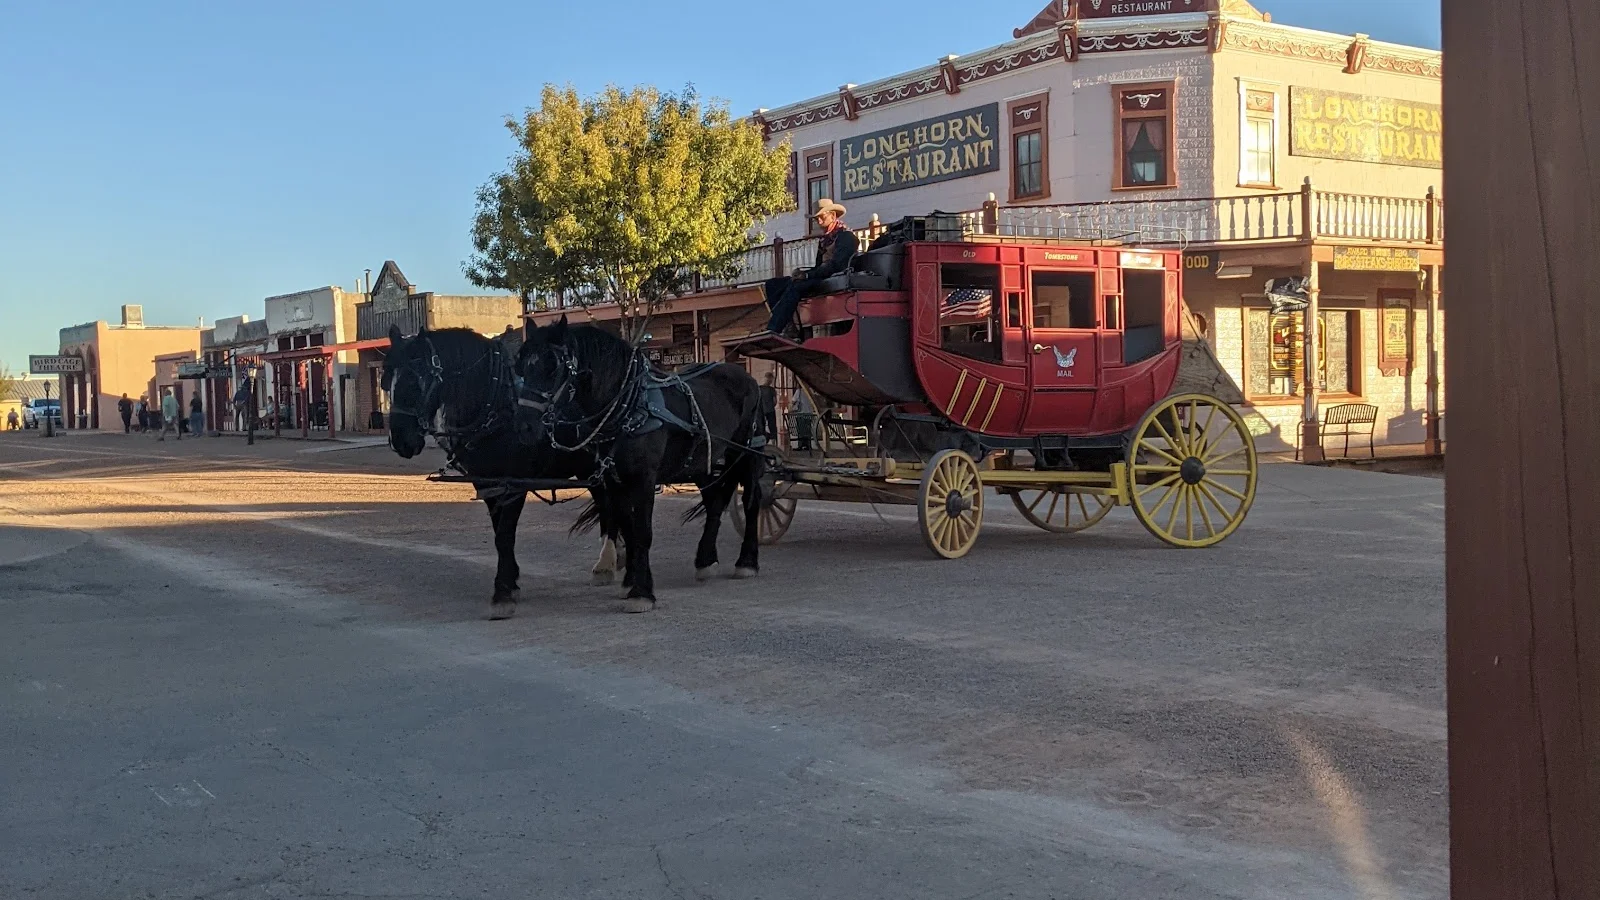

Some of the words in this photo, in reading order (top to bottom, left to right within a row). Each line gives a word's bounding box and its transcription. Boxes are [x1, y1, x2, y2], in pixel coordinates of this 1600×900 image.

[1111, 1, 1172, 14] RESTAURANT
[844, 112, 990, 167] LONGHORN
[1295, 120, 1442, 161] RESTAURAN
[844, 139, 994, 193] RESTAURANT
[962, 249, 976, 258] OLD
[1044, 251, 1078, 261] TOMBSTONE
[1184, 255, 1209, 269] OOD
